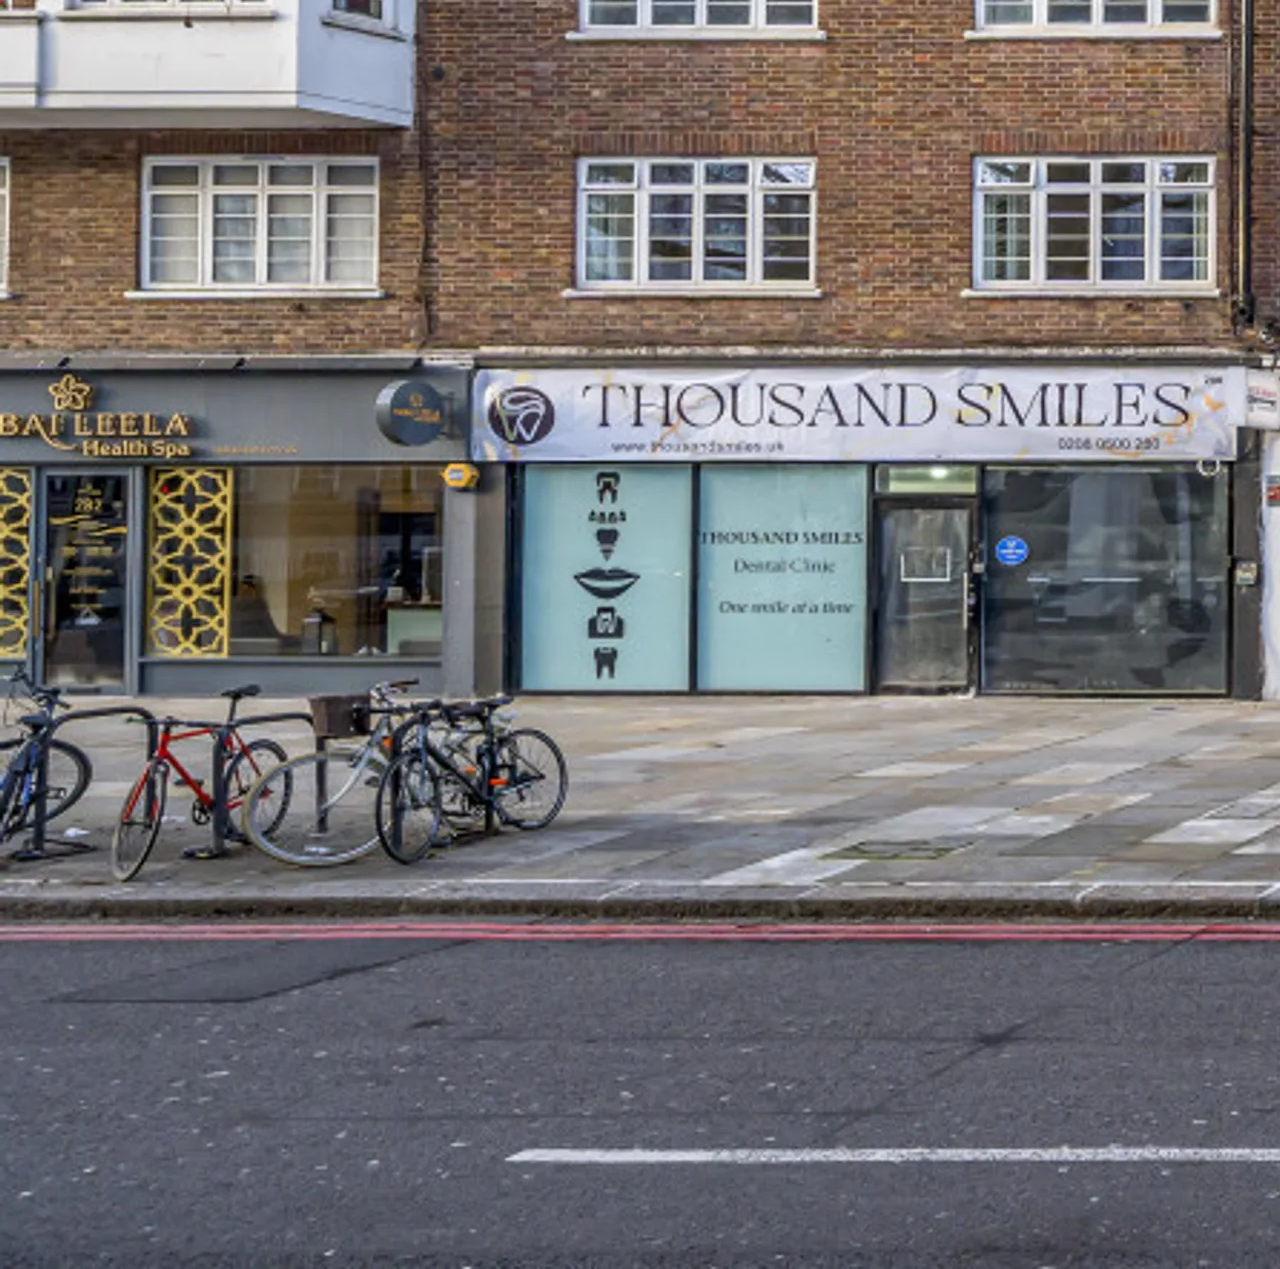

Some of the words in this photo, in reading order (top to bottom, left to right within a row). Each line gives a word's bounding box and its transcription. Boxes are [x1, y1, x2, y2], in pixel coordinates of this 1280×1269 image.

[583, 383, 937, 427] THOUSAND
[956, 383, 1191, 427] SMILES
[74, 412, 188, 436] LEELA
[83, 440, 147, 456] Health
[152, 440, 191, 458] Spa
[700, 532, 799, 544] THOUSAND
[803, 532, 864, 544] SMILES
[734, 558, 786, 573] Dental
[789, 558, 836, 573] Clinic
[719, 601, 748, 614] One
[751, 601, 789, 614] smile
[822, 601, 854, 614] time
